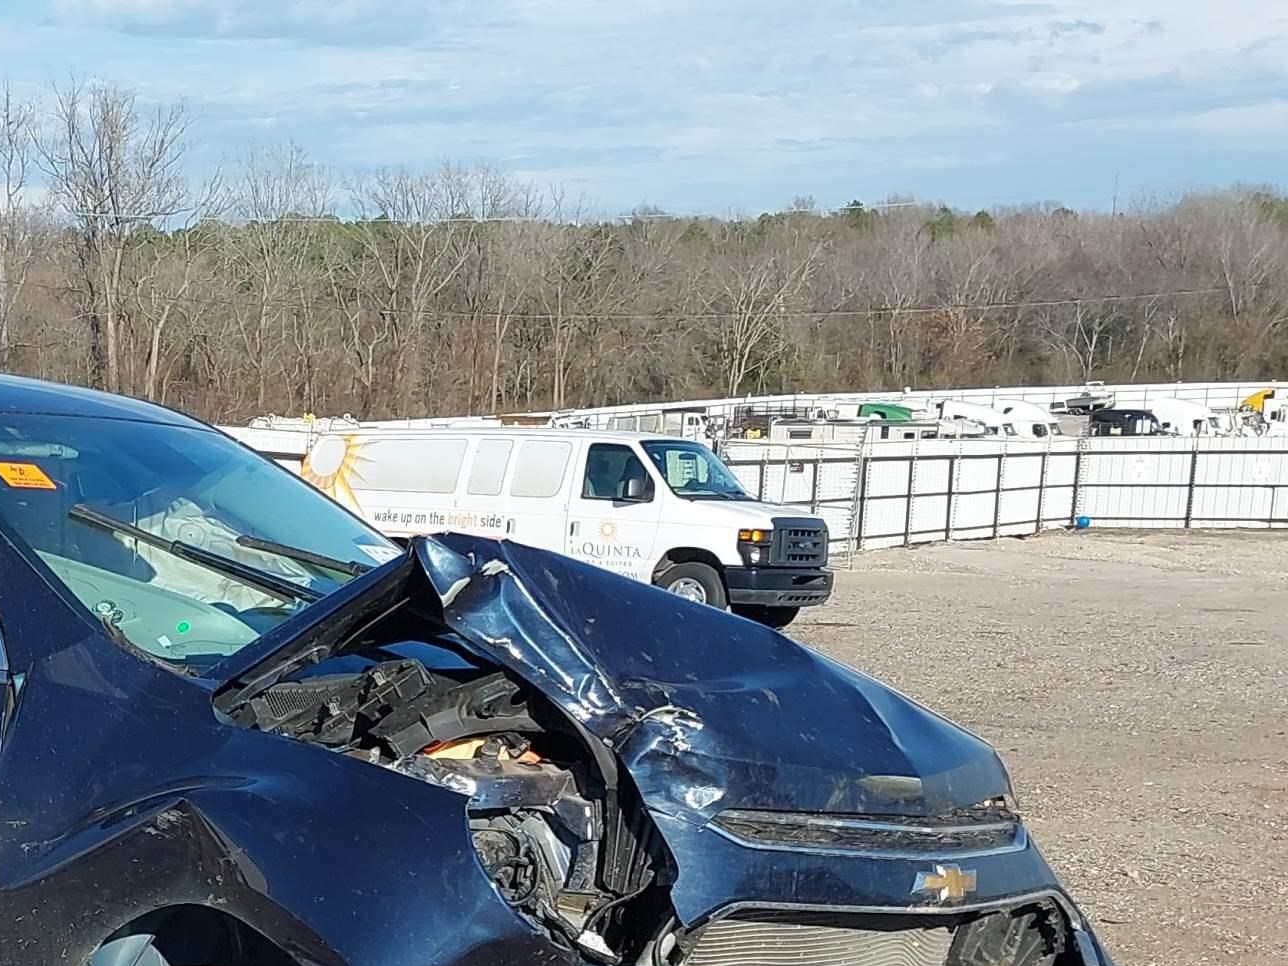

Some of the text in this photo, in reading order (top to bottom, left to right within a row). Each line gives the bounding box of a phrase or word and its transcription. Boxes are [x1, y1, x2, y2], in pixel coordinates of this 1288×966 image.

[374, 509, 398, 522] wake
[401, 512, 412, 526] up
[415, 513, 426, 524] on
[429, 512, 444, 525] the
[447, 511, 478, 529] bright
[571, 541, 641, 558] LA QUINTA
